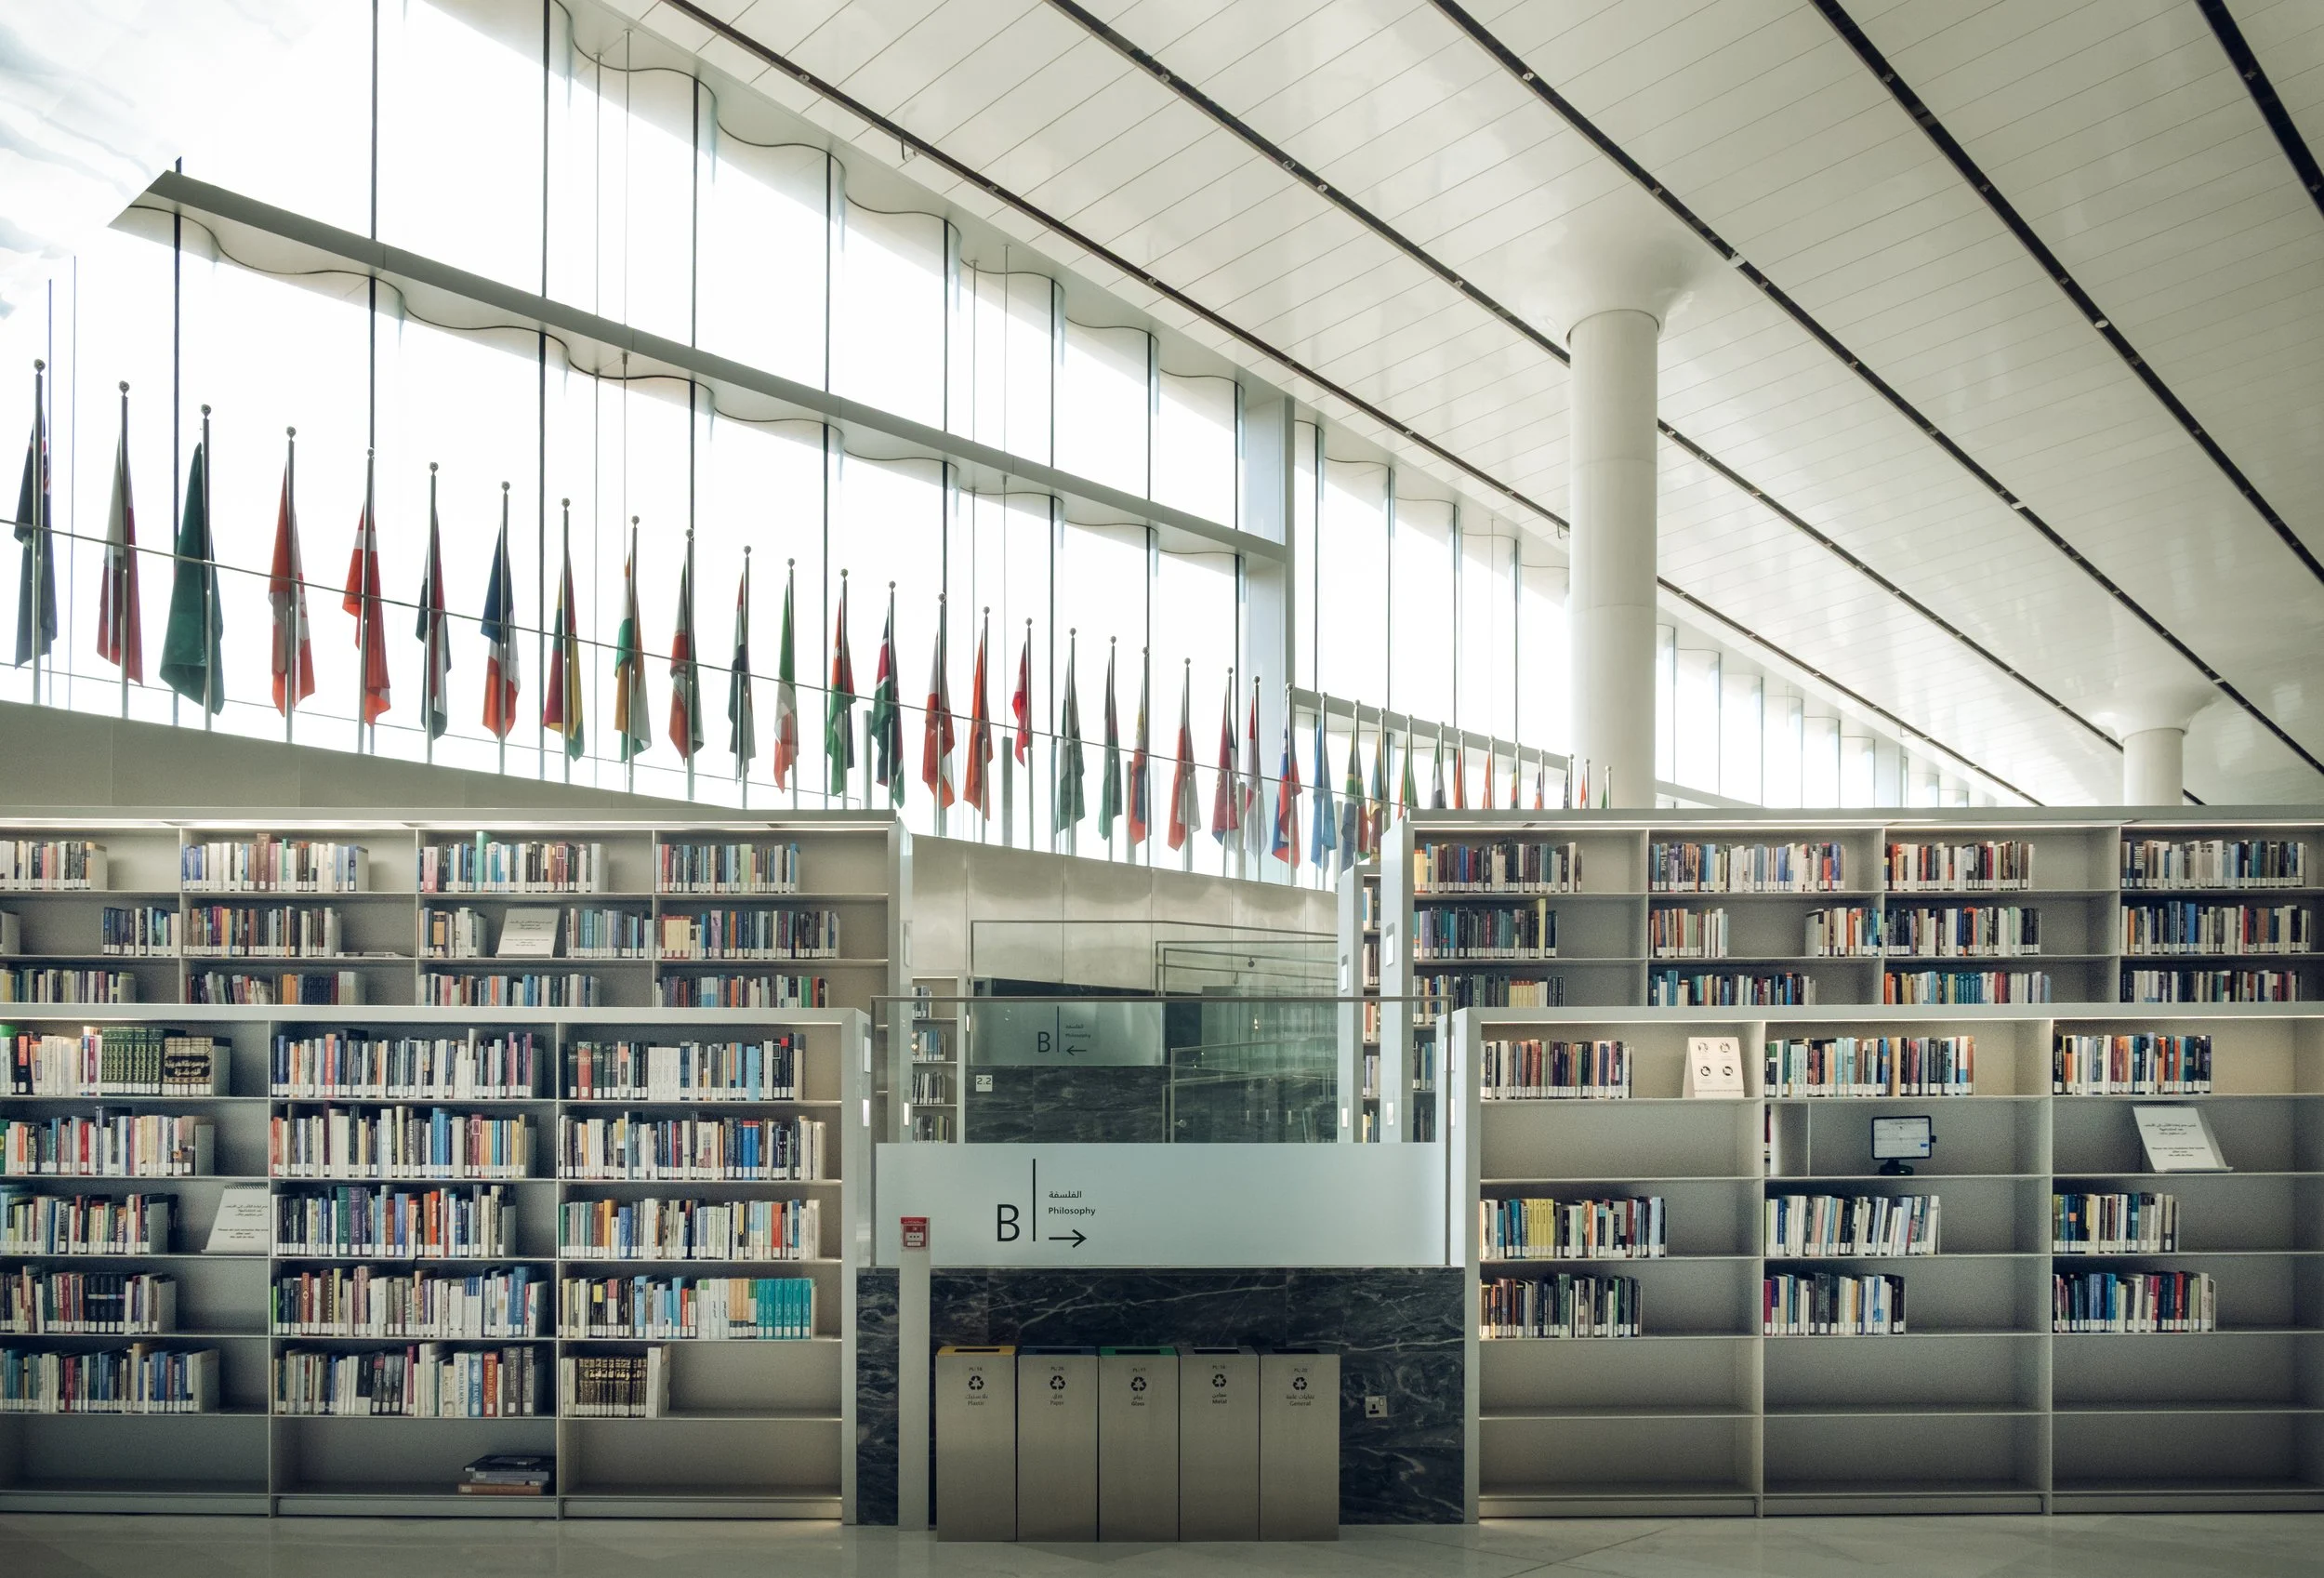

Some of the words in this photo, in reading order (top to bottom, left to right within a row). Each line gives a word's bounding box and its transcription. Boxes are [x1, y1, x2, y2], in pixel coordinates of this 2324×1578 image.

[1037, 1031, 1051, 1053] B
[1048, 1207, 1096, 1216] Philosophy
[997, 1204, 1020, 1242] B
